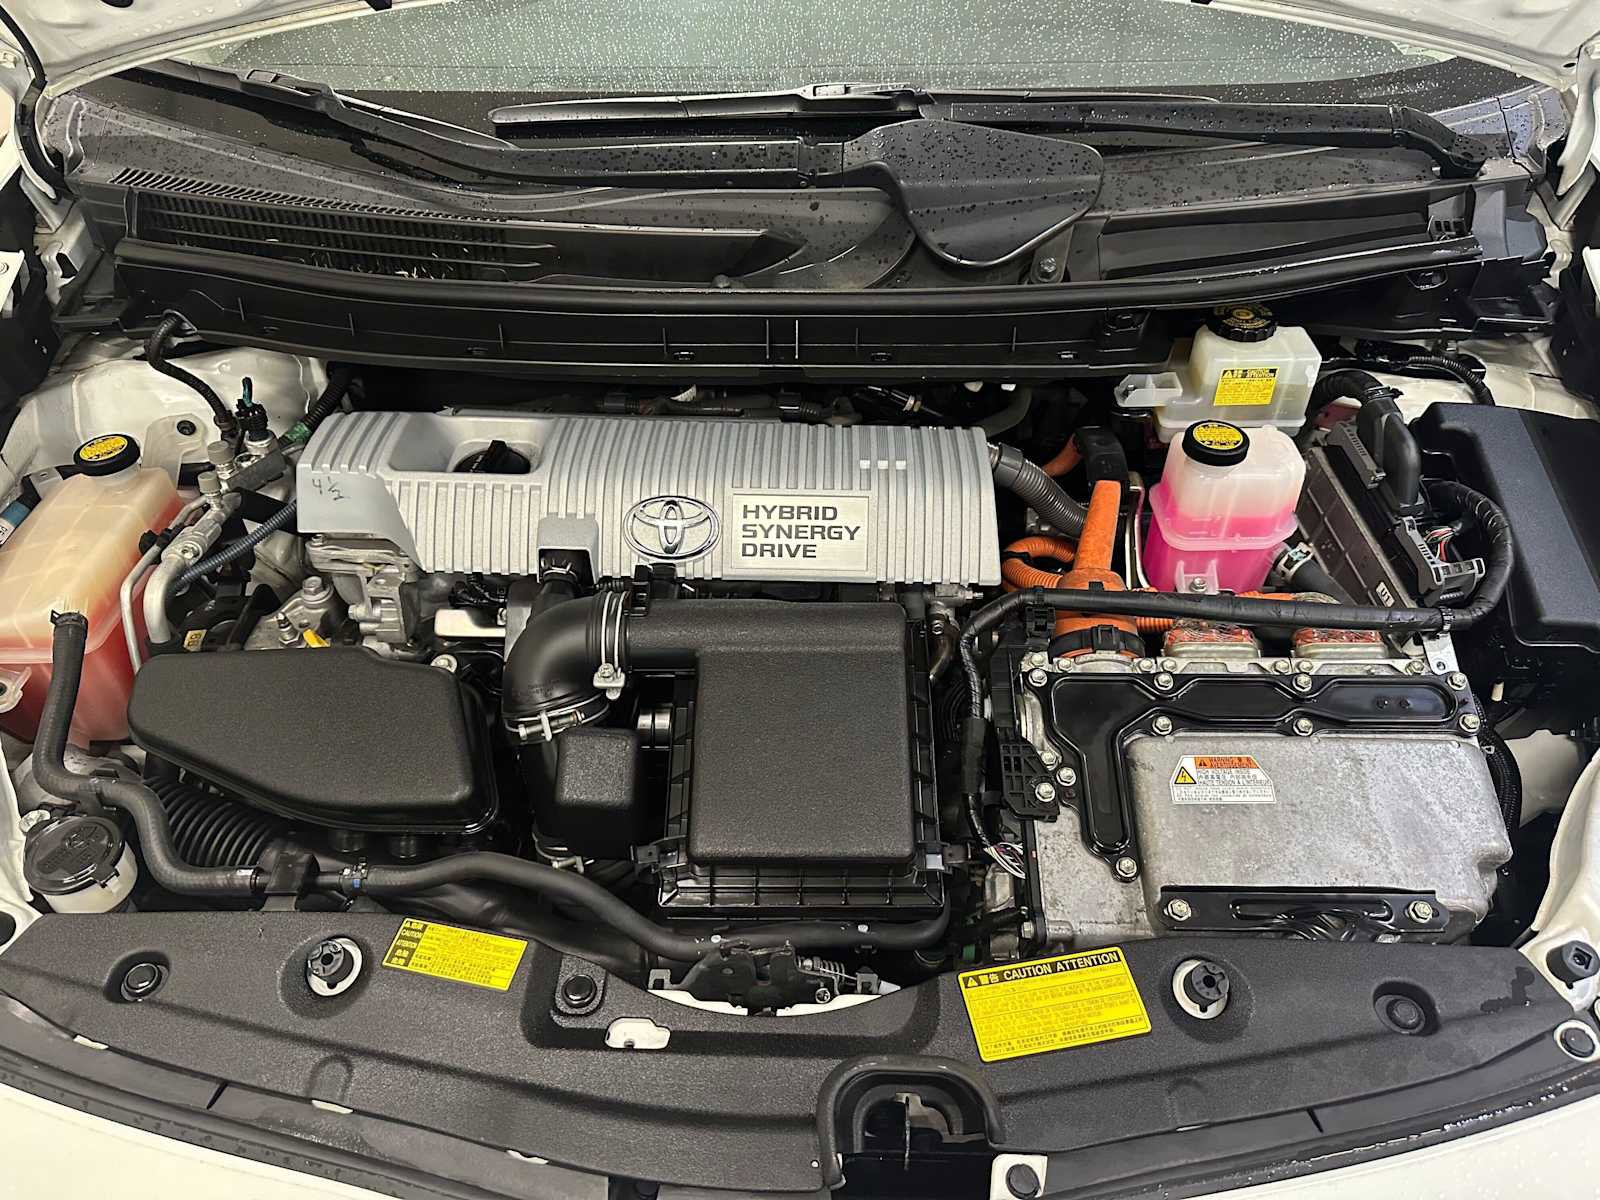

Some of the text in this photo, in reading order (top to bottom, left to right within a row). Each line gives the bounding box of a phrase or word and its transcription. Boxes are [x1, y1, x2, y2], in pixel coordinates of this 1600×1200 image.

[743, 504, 838, 521] HYBRID
[742, 523, 861, 541] SYNERGY
[741, 543, 817, 559] DRIVE
[1003, 962, 1053, 981] CAUTION
[1056, 951, 1119, 972] ATTENTION
